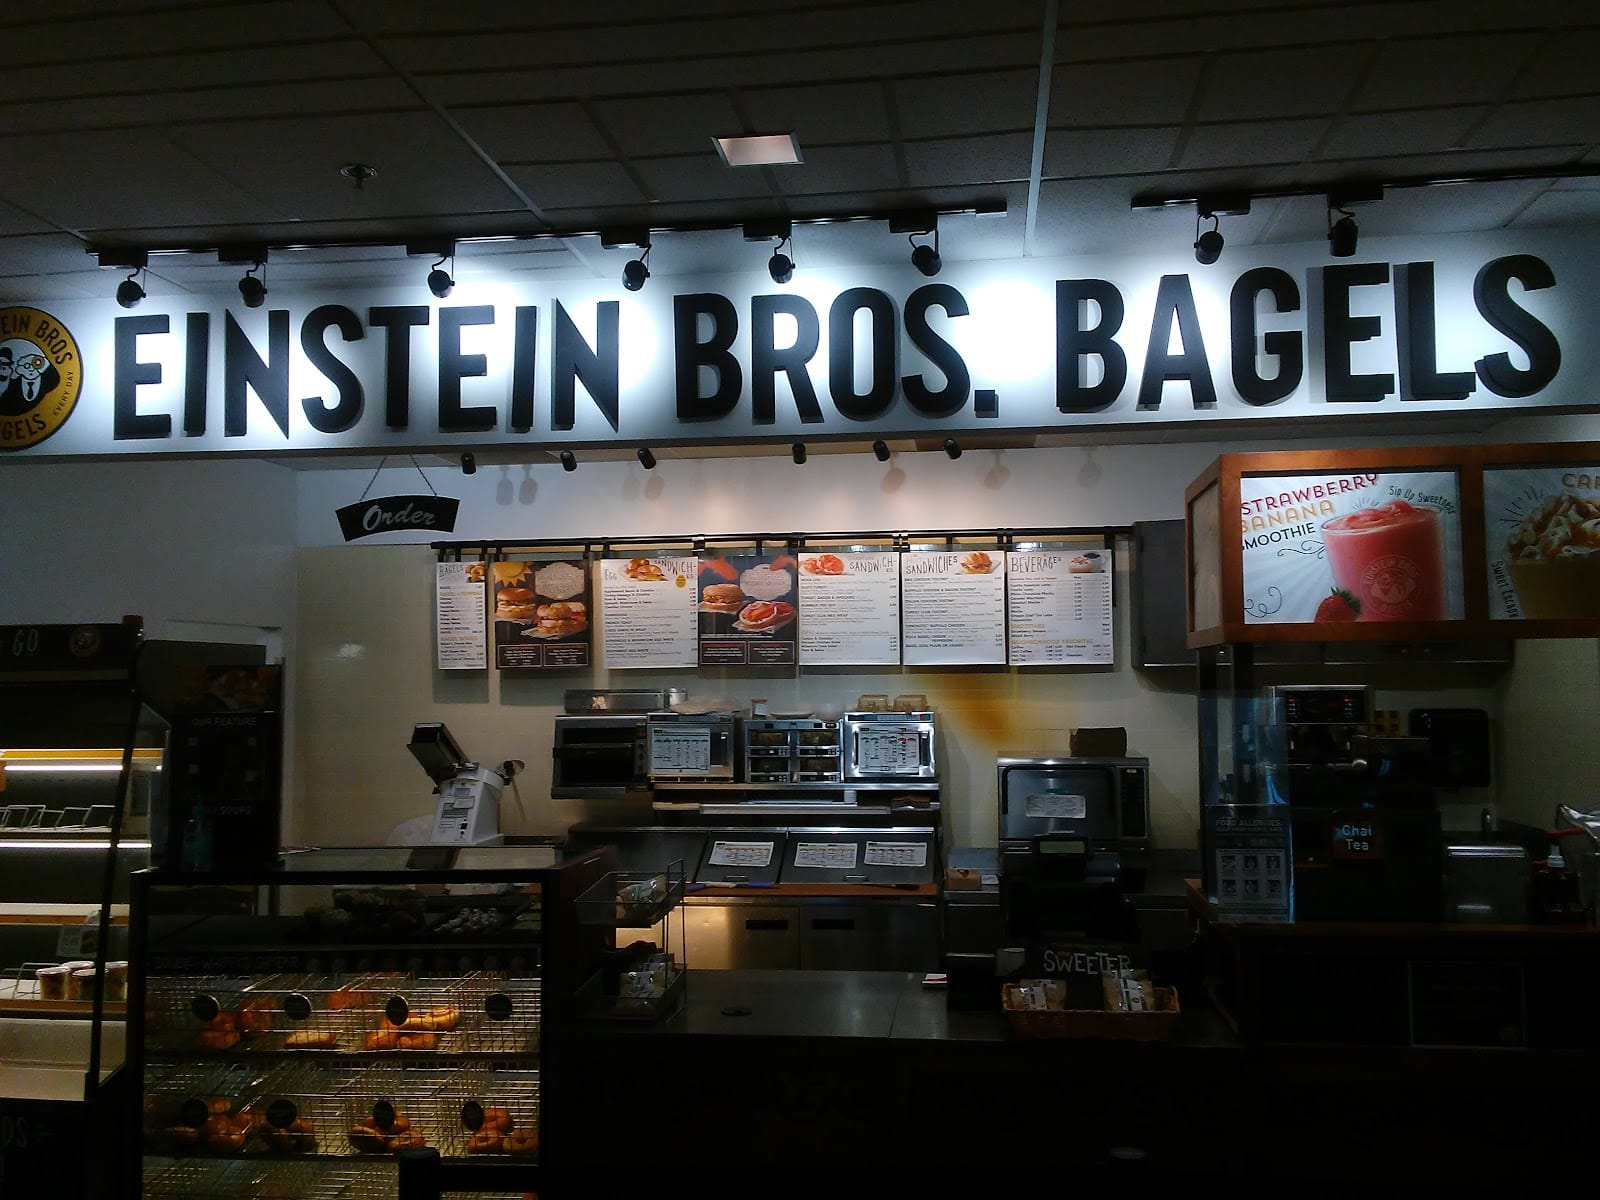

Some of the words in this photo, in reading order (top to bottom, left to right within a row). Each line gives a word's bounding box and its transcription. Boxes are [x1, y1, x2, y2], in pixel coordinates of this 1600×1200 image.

[34, 319, 73, 365] BROS
[115, 298, 619, 440] EINSTEIN
[674, 284, 998, 424] BROS.
[1056, 255, 1561, 413] BAGELS
[54, 391, 69, 416] EVERY
[65, 370, 73, 387] DAY
[1241, 471, 1378, 515] STRAWBERRY
[1389, 485, 1402, 498] Sip
[1404, 488, 1415, 501] Up
[362, 502, 436, 531] Order
[1241, 499, 1335, 533] BANANA
[1242, 522, 1316, 550] MOOTHIE
[439, 563, 464, 577] BAGELS
[906, 555, 959, 575] SANDWICHES
[1491, 560, 1510, 589] Sweet
[12, 628, 40, 657] GO
[1341, 824, 1373, 837] Chai
[1344, 838, 1370, 851] Tea
